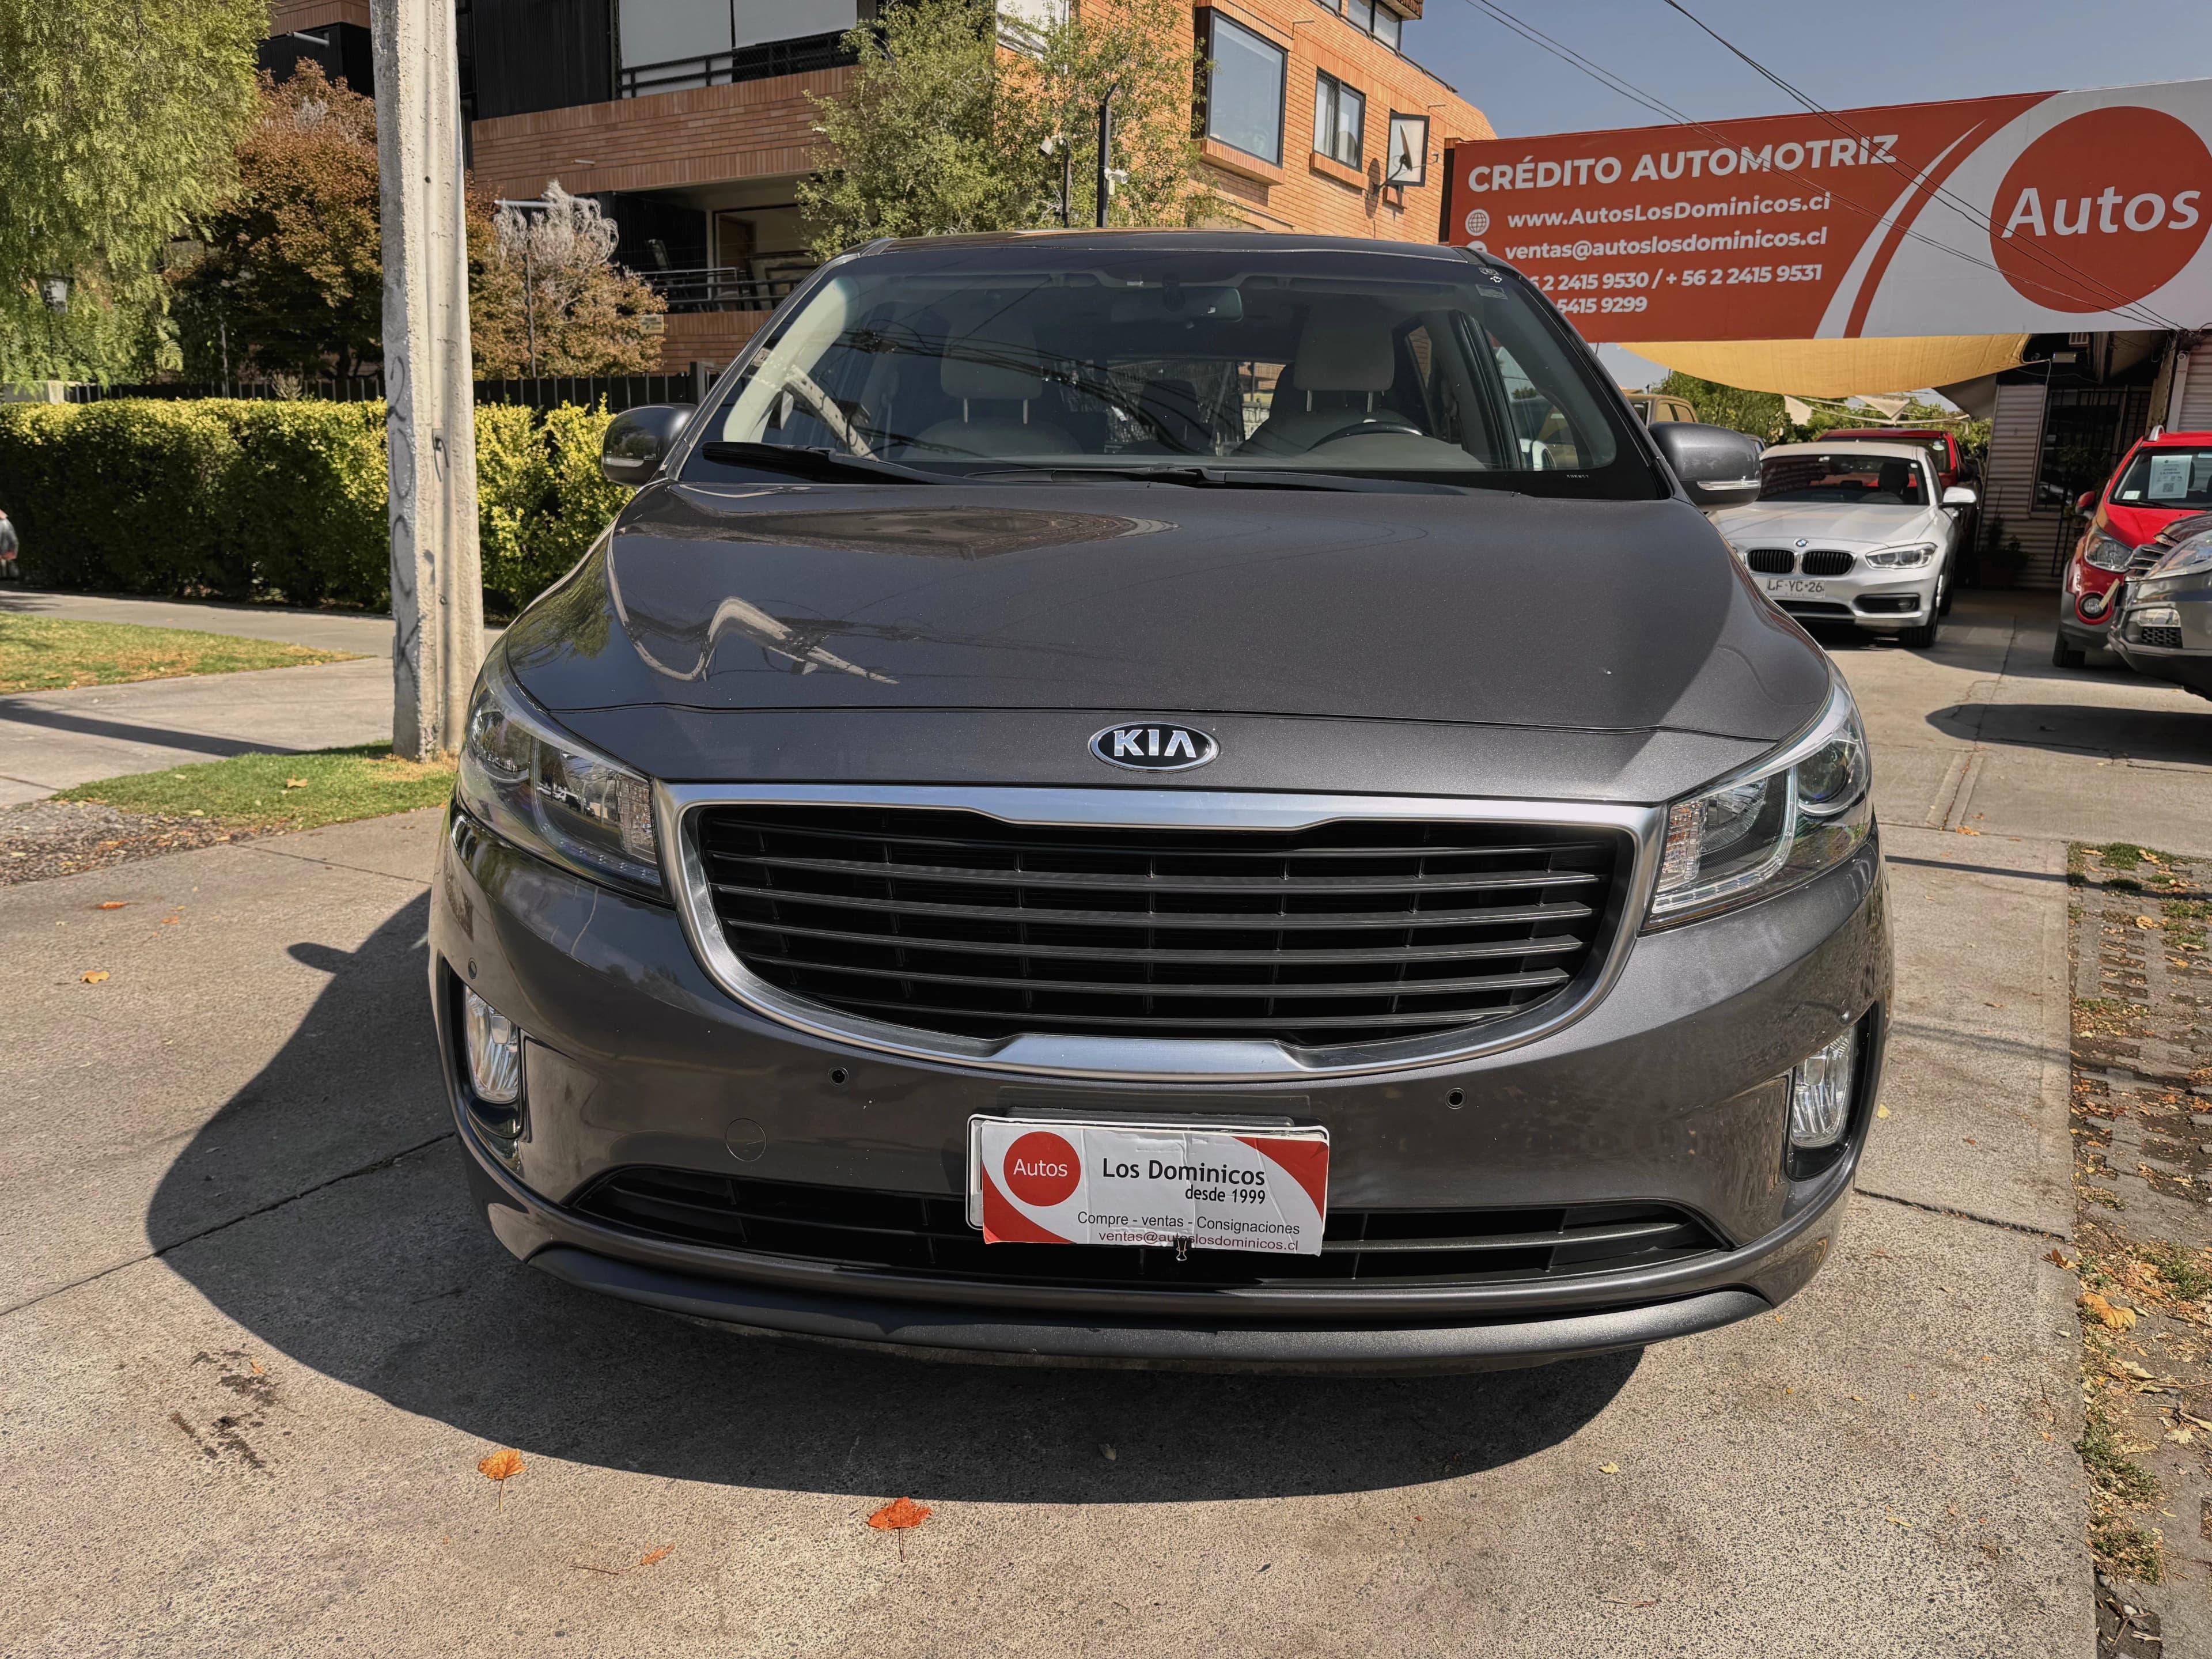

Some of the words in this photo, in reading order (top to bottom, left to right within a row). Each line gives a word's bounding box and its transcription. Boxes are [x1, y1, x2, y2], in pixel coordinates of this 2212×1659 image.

[1468, 156, 1622, 192] CRÉDITO
[1630, 134, 1899, 183] AUTOMOTRIZ
[1507, 190, 1831, 228] www.AutosLosDominicos.cl
[2001, 186, 2201, 238] Autos
[1504, 226, 1827, 261] ventas@autoslosdominicos.cl
[1542, 275, 1555, 291] 2
[1557, 274, 1599, 290] 2415
[1601, 271, 1650, 290] 9530
[1681, 269, 1707, 286] 56
[1709, 268, 1724, 285] 2
[1726, 266, 1772, 285] 2415
[1776, 264, 1823, 282] 9531
[1600, 296, 1648, 314] 9299
[1113, 729, 1196, 758] KIA
[1012, 1158, 1069, 1177] Autos
[1103, 1158, 1140, 1179] Los
[1149, 1160, 1266, 1186] Dominicos
[1185, 1184, 1226, 1203] desde
[1230, 1188, 1267, 1205] 1999
[1077, 1211, 1129, 1228] Compre
[1141, 1215, 1184, 1227] ventas
[1196, 1216, 1301, 1235] Consignaciones
